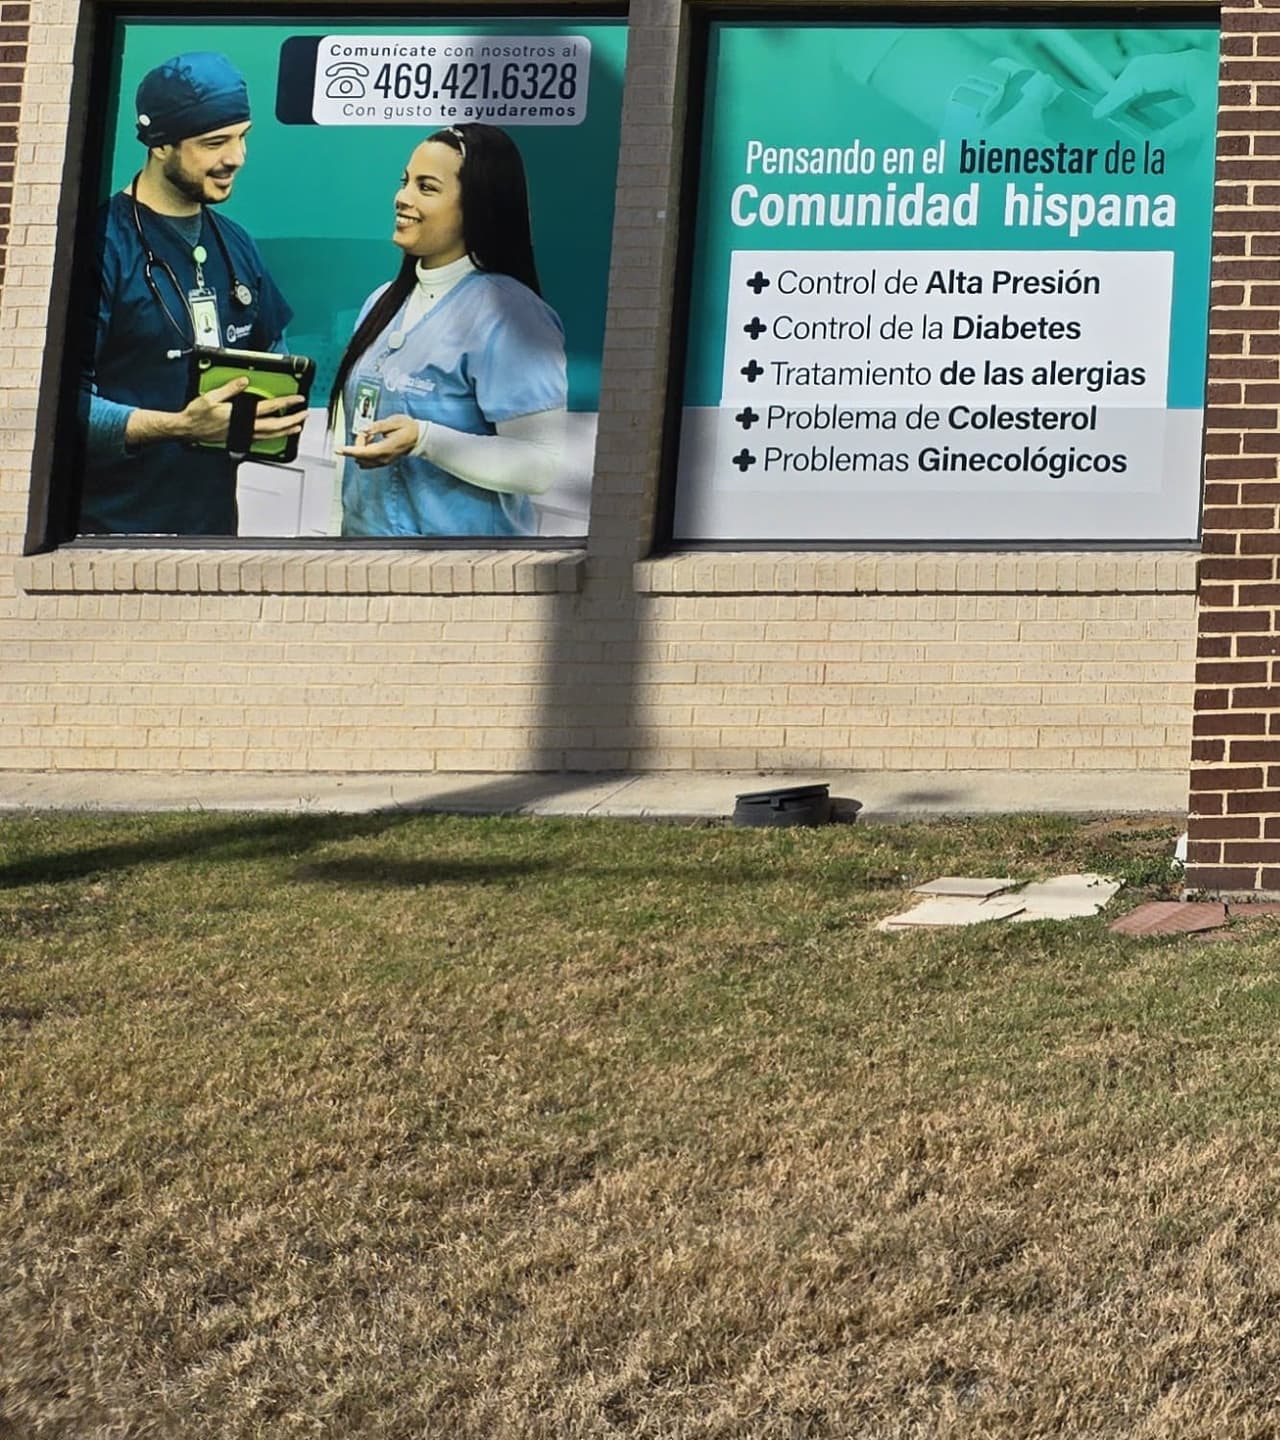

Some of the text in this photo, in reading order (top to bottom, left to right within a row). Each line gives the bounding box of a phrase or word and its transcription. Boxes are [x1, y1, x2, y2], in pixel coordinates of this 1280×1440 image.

[330, 44, 577, 58] Comunícate con nosotros al
[374, 63, 577, 99] 469.421.6328
[343, 103, 576, 120] Con gusto te ayudaremos
[745, 140, 1165, 175] Pensando en el bienestar de la
[731, 182, 1176, 237] Comunidad hispana
[777, 269, 1100, 295] Control de Alta Presión
[772, 315, 1081, 340] Control de la Diabetes
[771, 361, 1146, 391] Tratamiento de las alergias
[767, 405, 1097, 430] Problema de Colesterol
[764, 446, 1128, 478] Problemas Ginecológicos
